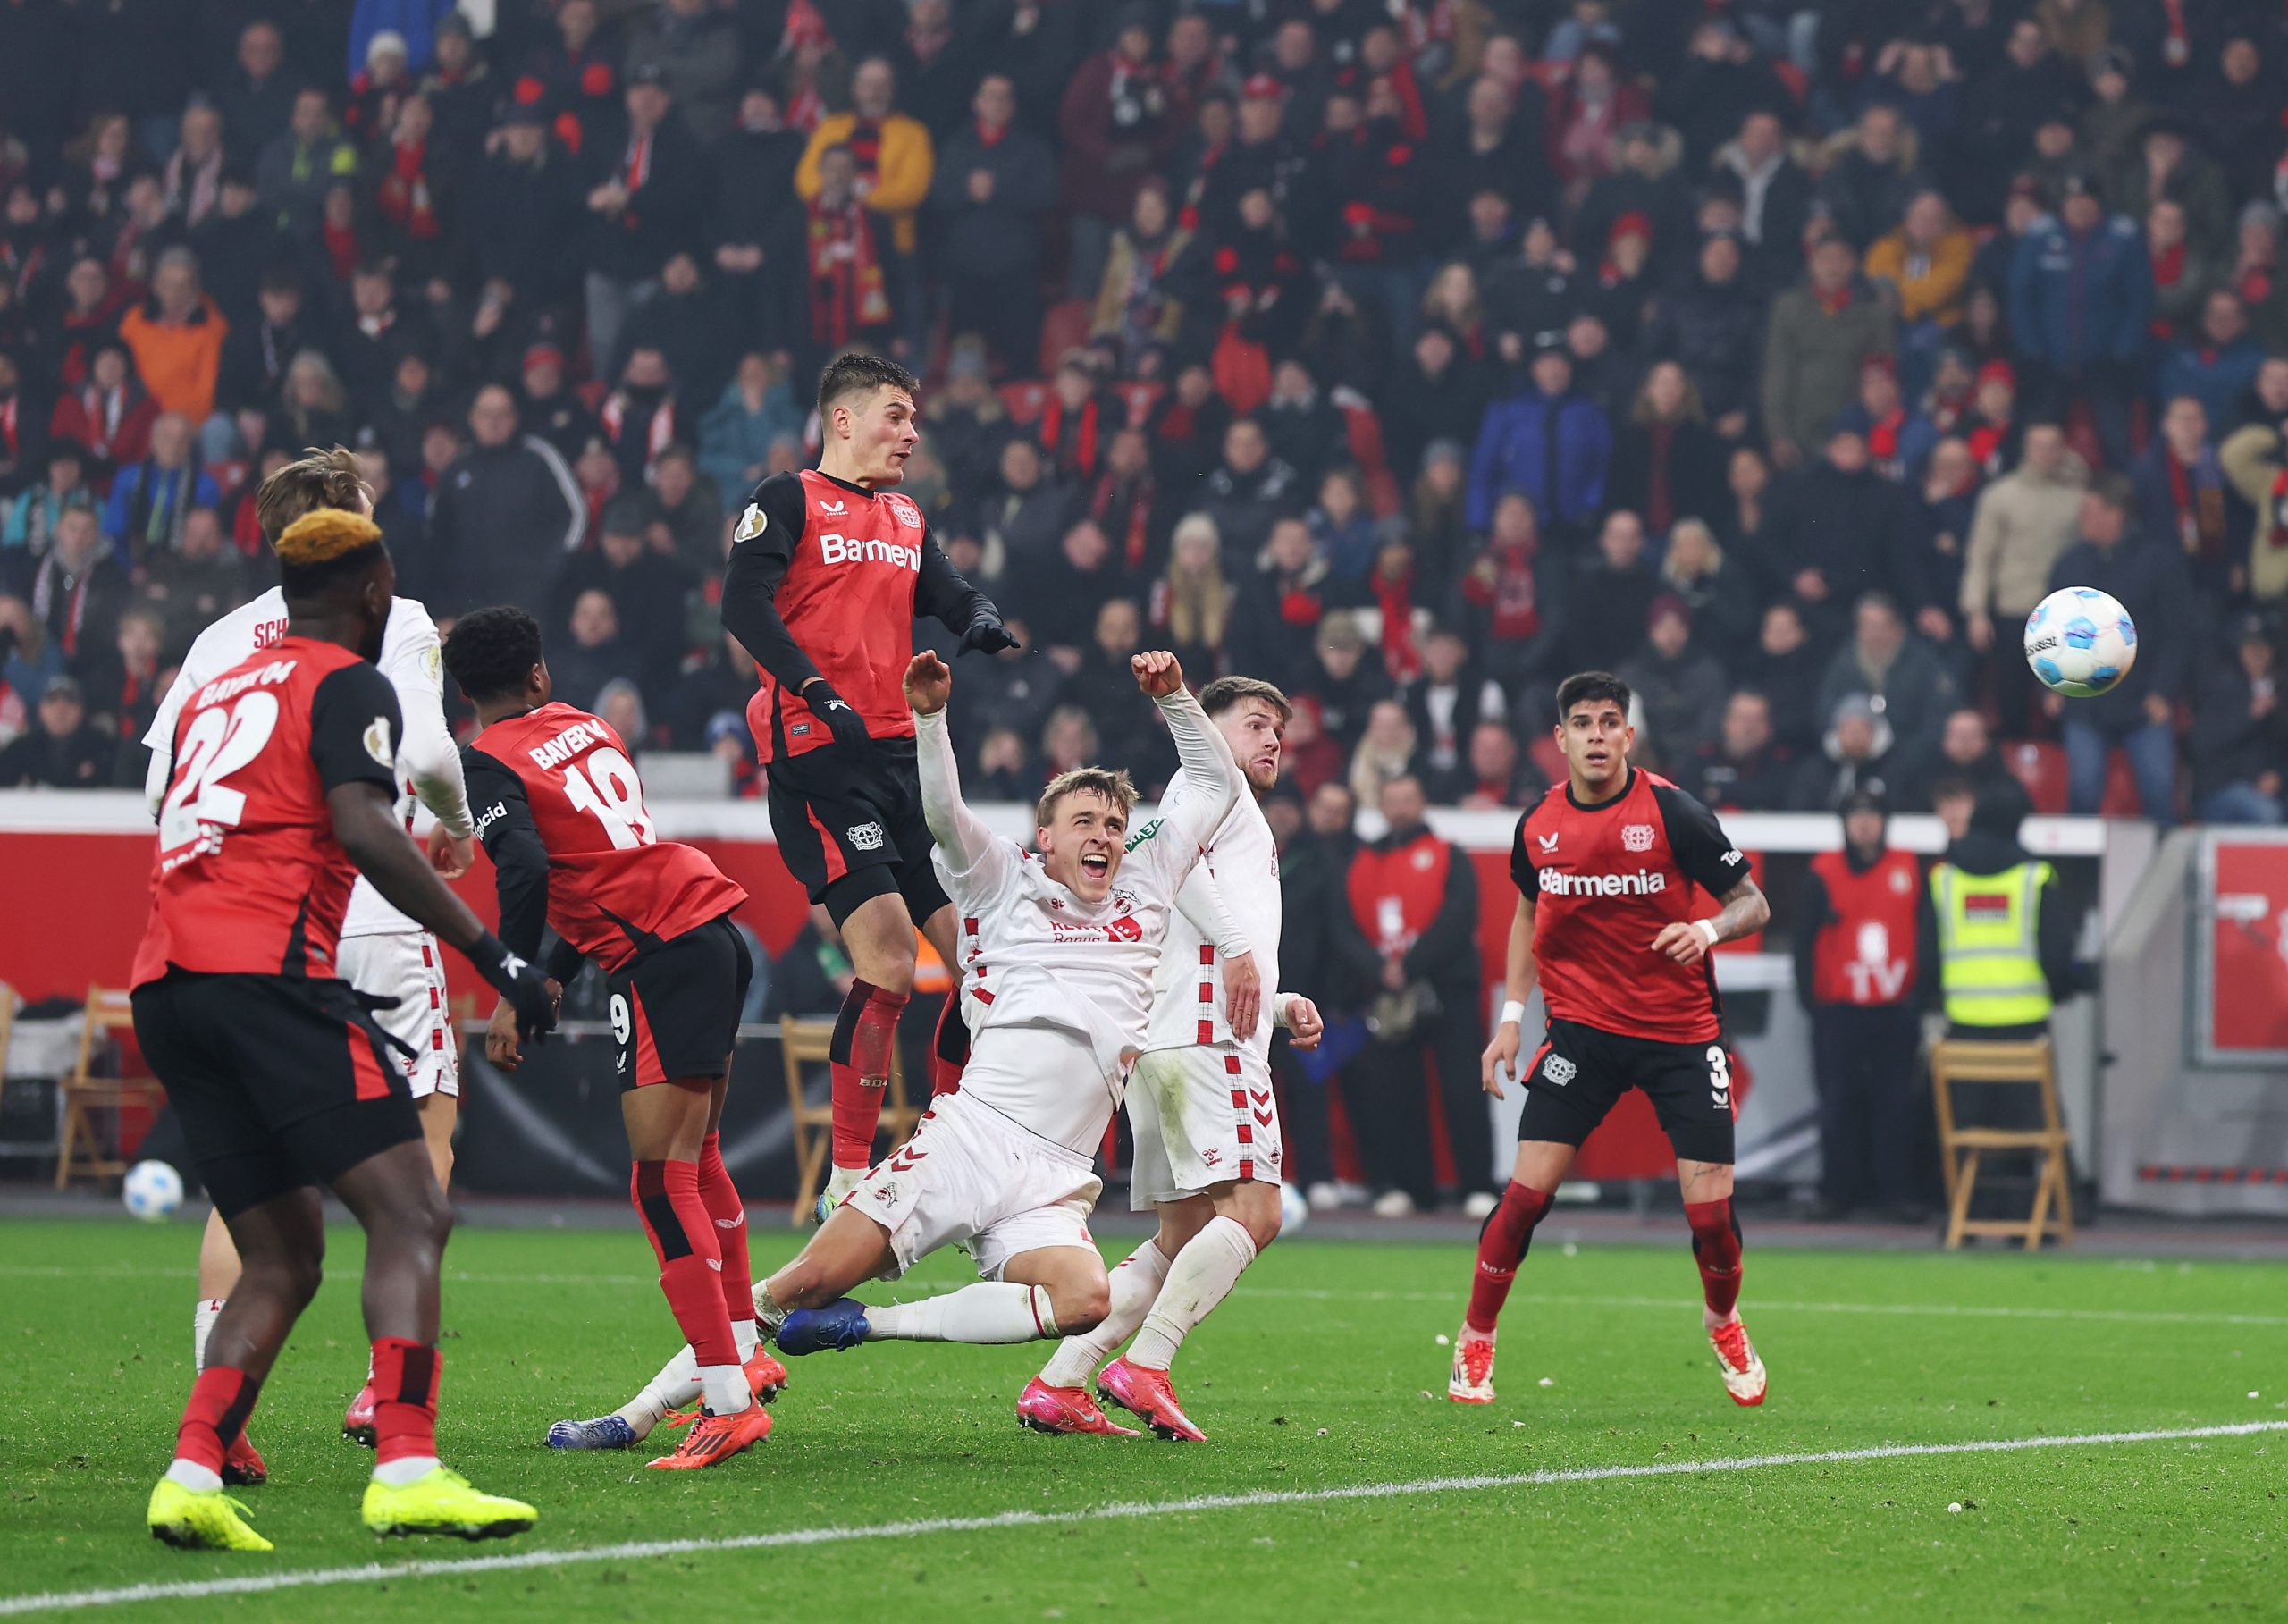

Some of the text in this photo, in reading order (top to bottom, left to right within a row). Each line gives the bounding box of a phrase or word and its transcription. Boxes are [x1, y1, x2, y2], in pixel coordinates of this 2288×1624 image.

[260, 660, 298, 686] 04
[528, 724, 595, 770] BAYER
[159, 691, 279, 854] 22
[1538, 867, 1666, 896] Barmenia
[1844, 958, 1909, 1003] TV
[1706, 1045, 1730, 1089] 3
